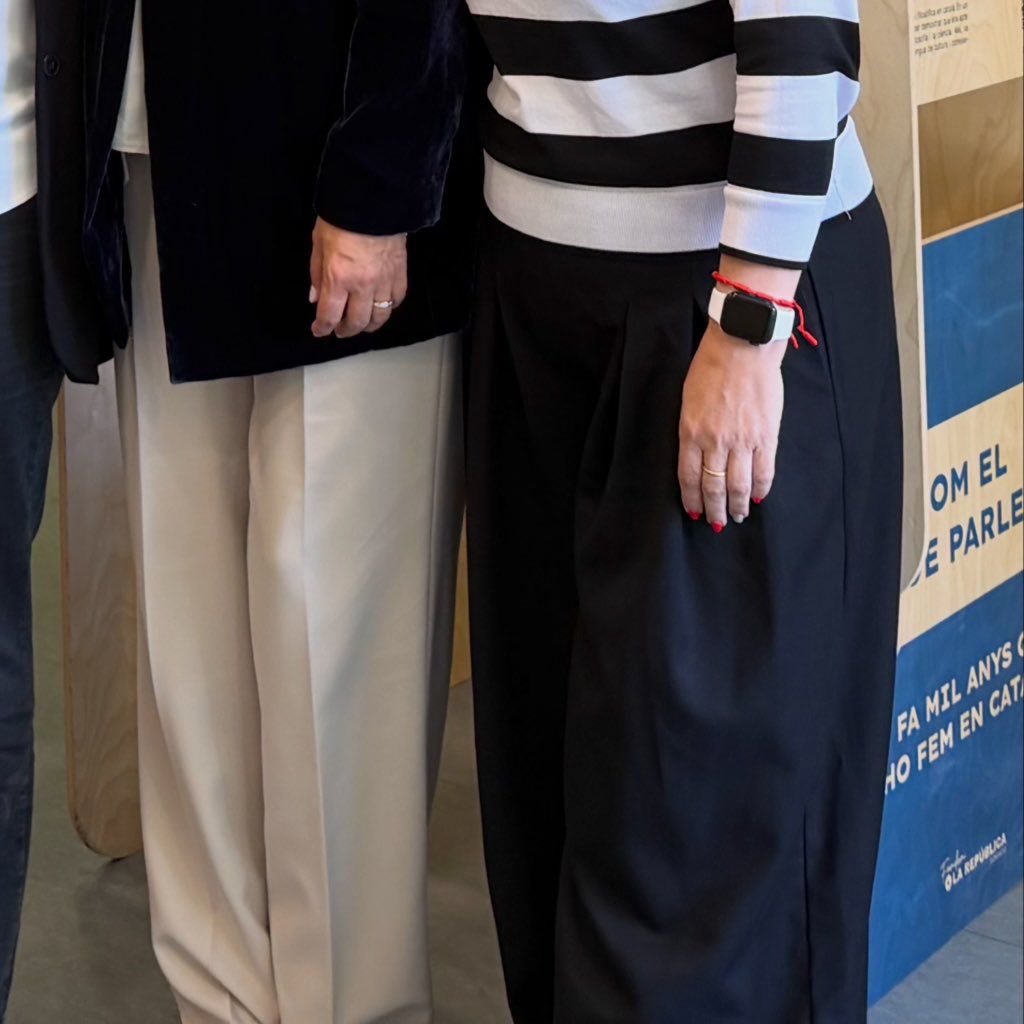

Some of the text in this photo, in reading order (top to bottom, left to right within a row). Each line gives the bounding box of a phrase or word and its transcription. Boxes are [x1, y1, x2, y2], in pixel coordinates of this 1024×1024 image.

[930, 443, 1008, 512] OM EL
[949, 488, 1023, 563] PARLE
[897, 705, 921, 742] FA
[926, 678, 962, 723] MIL
[967, 641, 1012, 695] ANYS
[917, 722, 954, 771] FEM
[960, 701, 983, 740] EN
